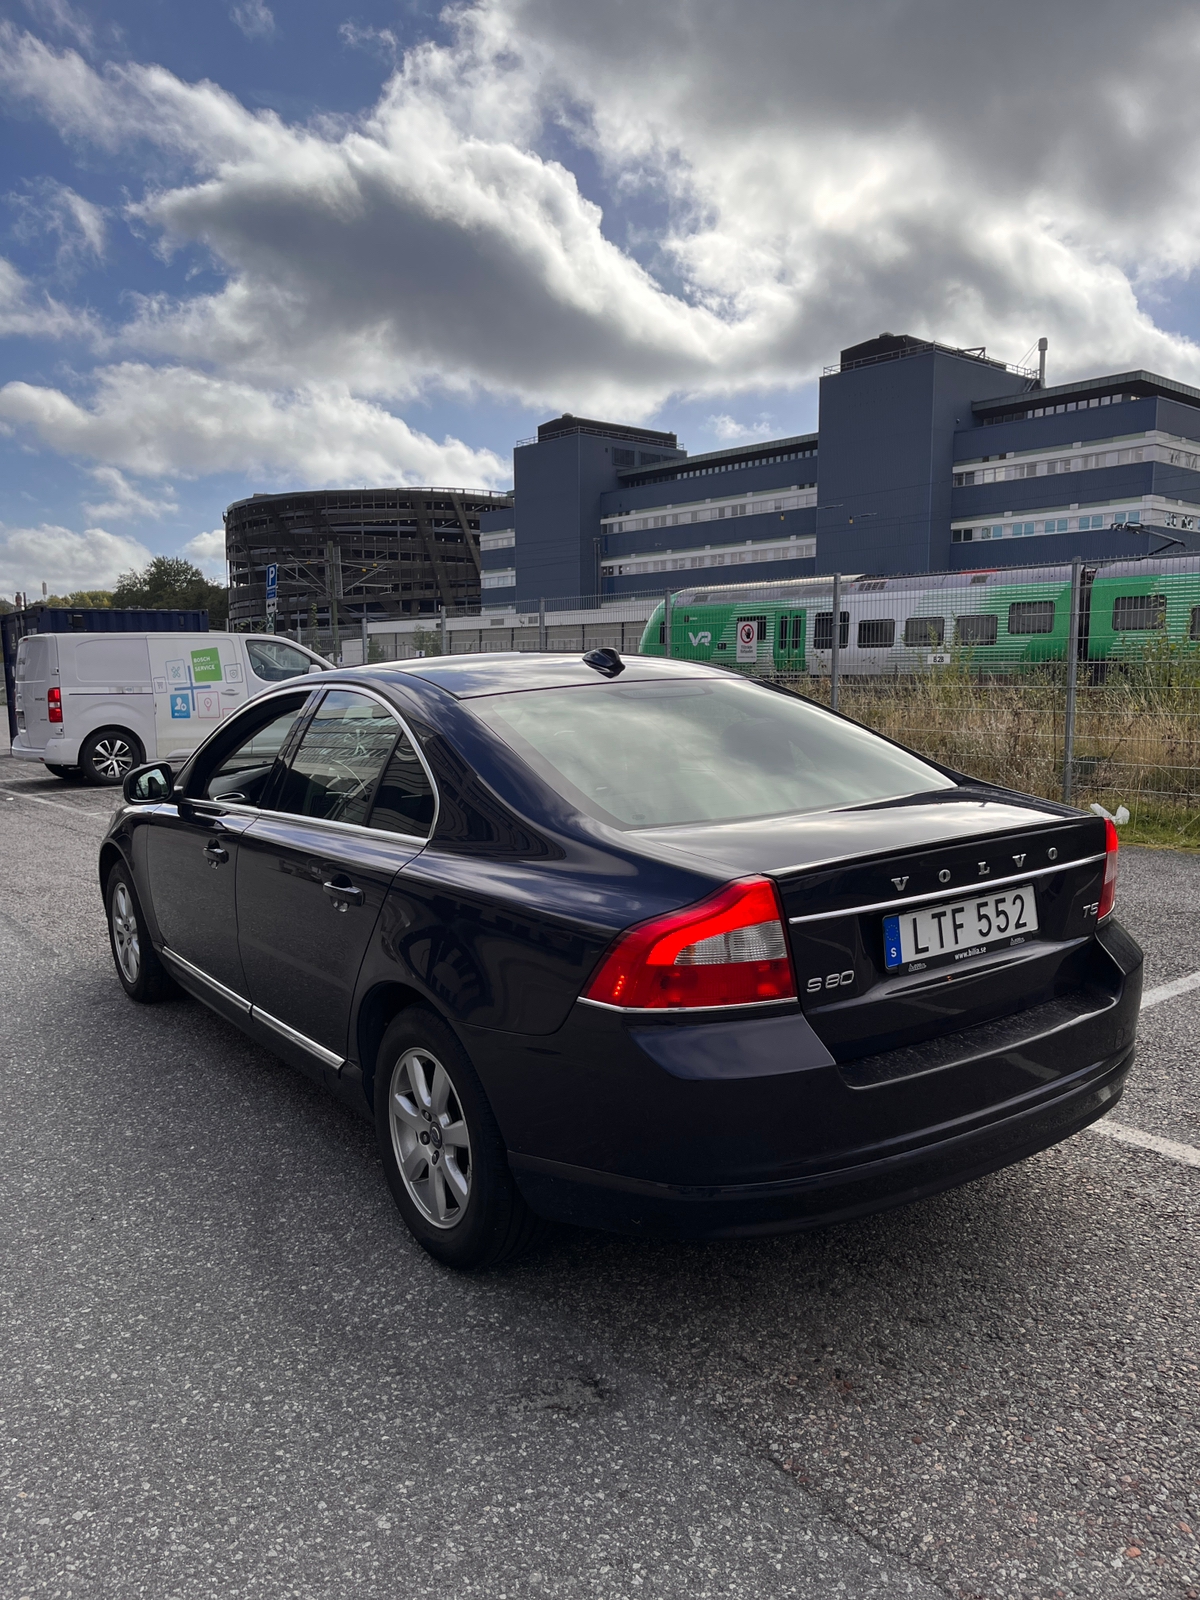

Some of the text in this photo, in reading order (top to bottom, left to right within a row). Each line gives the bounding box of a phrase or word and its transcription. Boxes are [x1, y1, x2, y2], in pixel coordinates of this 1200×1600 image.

[269, 566, 276, 586] P
[688, 631, 711, 647] VR
[194, 664, 216, 672] SERVICE
[891, 847, 1058, 892] VOLVO
[1083, 902, 1099, 918] T5
[912, 894, 1027, 955] LTF 552
[890, 947, 897, 958] S
[954, 946, 987, 960] www.bilia.se
[806, 970, 855, 993] S80
